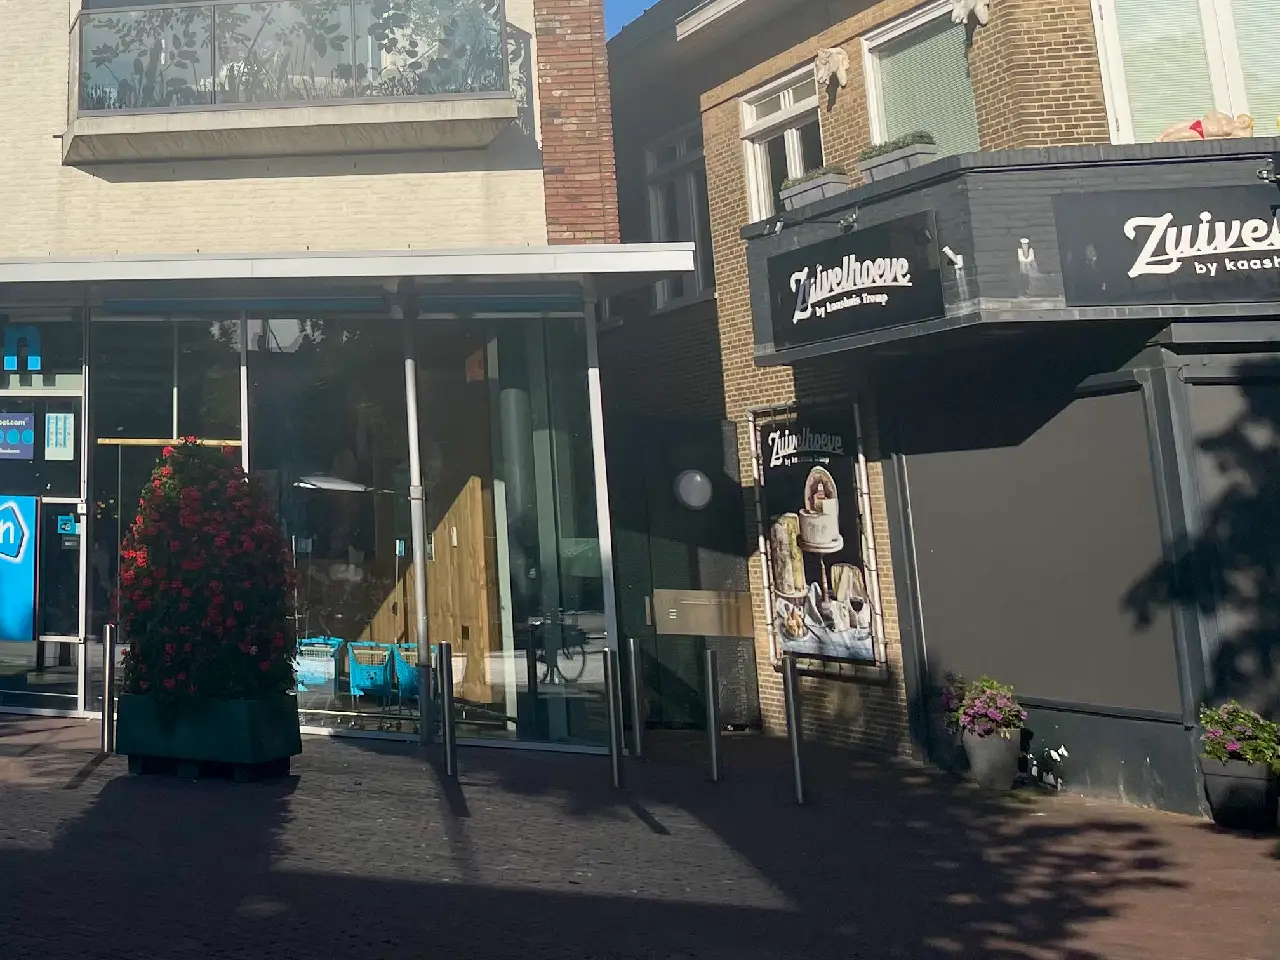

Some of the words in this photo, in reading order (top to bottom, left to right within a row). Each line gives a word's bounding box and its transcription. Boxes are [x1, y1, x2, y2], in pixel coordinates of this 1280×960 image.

[1194, 261, 1218, 277] by
[790, 254, 913, 324] Zuivelhoeve
[815, 306, 826, 318] by
[862, 292, 889, 306] Tromp
[768, 427, 845, 468] Zuivelhoeve
